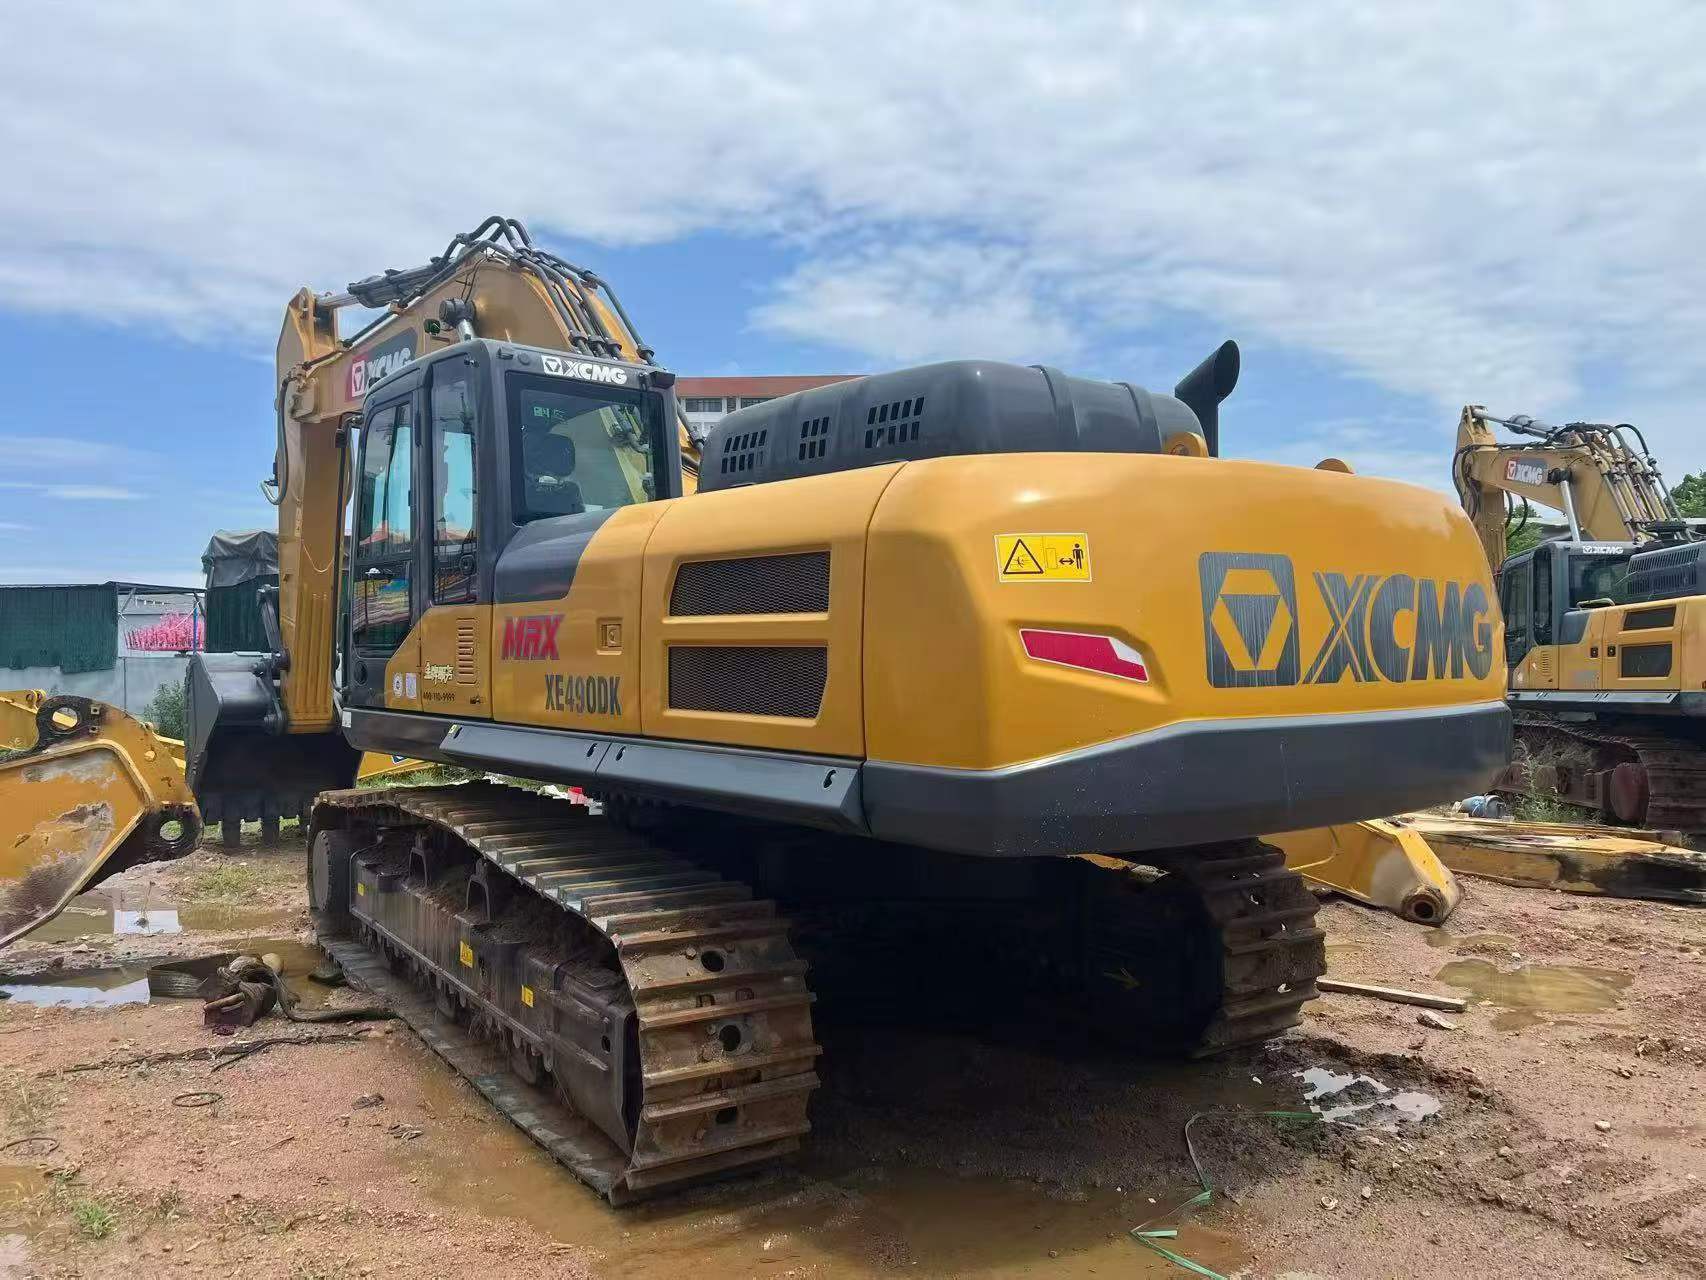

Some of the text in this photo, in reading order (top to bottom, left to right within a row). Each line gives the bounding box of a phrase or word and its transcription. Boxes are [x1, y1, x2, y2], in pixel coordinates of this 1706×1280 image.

[366, 347, 412, 391] XCMG
[563, 360, 628, 385] XCMG
[1516, 463, 1543, 485] XCMG
[1593, 545, 1624, 555] XCMG
[1302, 571, 1493, 684] XCMG
[544, 673, 621, 716] XE490DK
